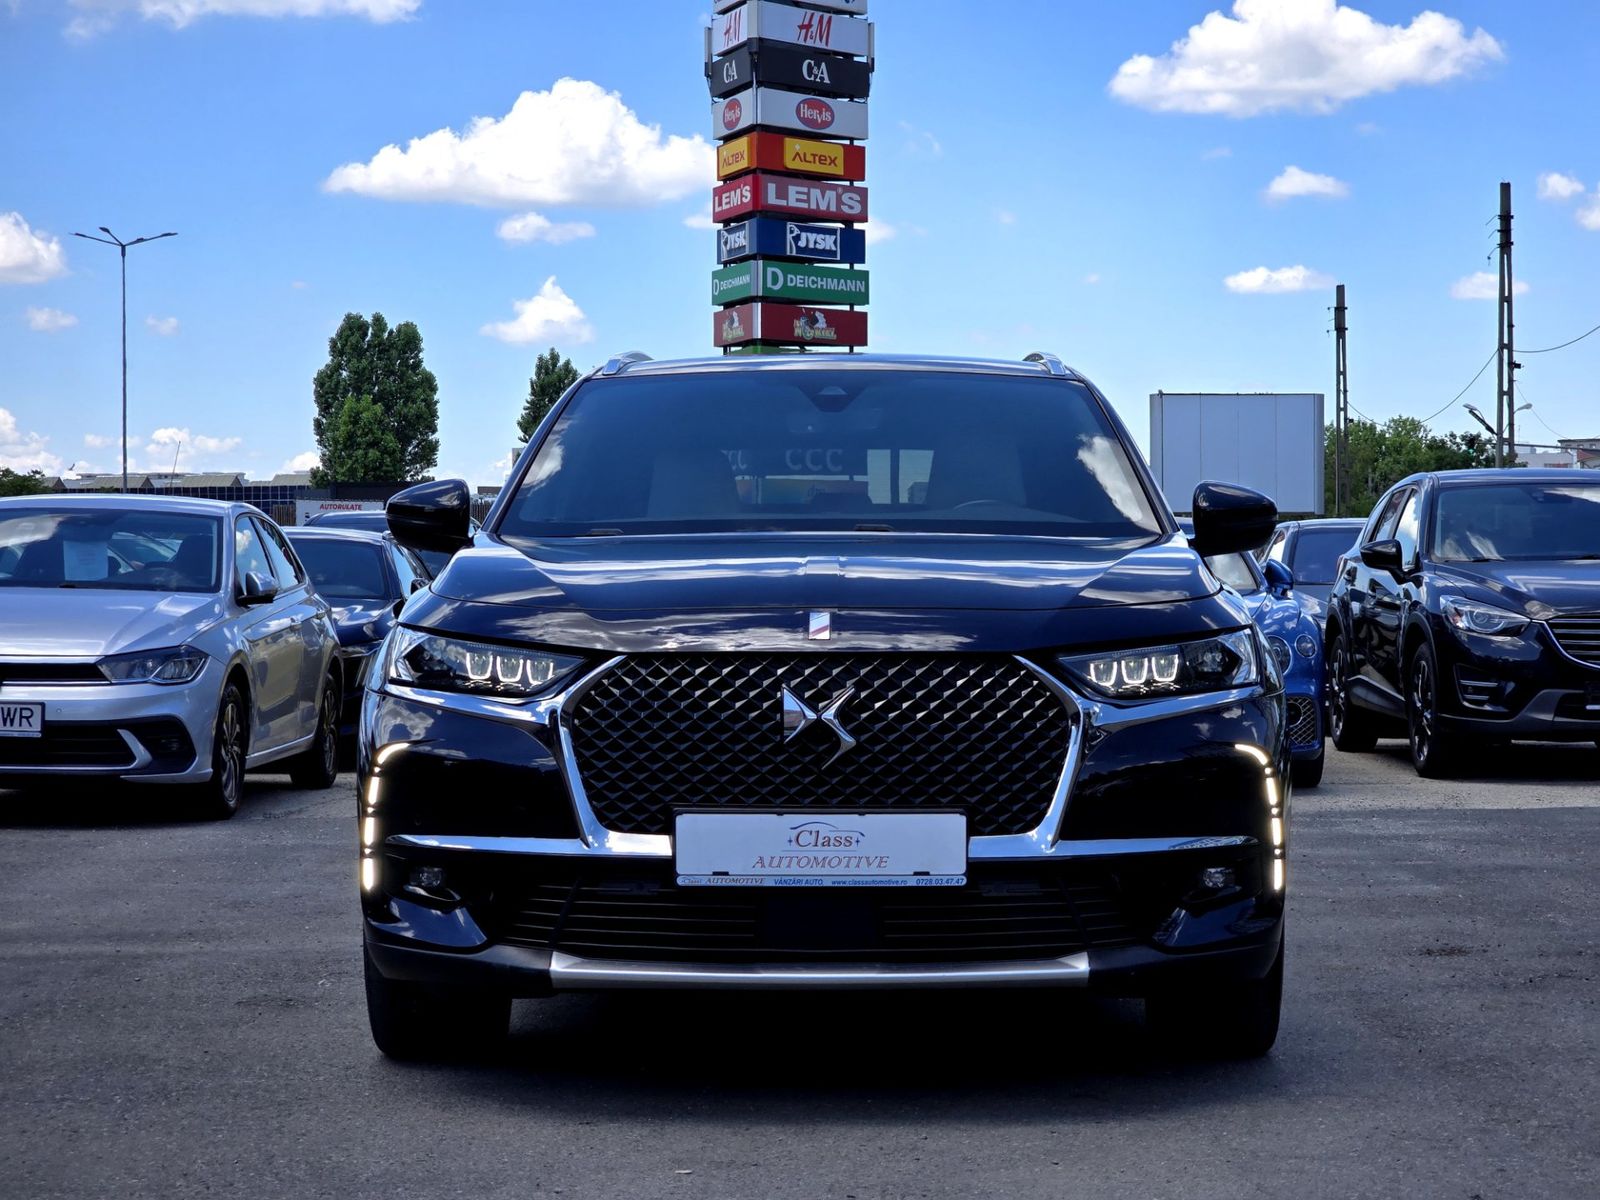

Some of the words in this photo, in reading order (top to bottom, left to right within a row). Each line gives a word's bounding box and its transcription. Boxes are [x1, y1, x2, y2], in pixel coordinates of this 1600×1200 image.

[797, 11, 833, 47] H&M
[723, 59, 738, 84] C&A
[802, 59, 831, 84] C&A
[724, 105, 741, 123] Hervis
[800, 103, 832, 124] Hervis
[714, 184, 751, 213] LEM'S
[726, 230, 747, 251] JYSK
[797, 232, 837, 251] JYSK
[720, 274, 750, 291] DEICHMANN
[766, 266, 784, 290] D
[787, 273, 865, 293] DEICHMANN
[785, 448, 843, 472] CCC
[319, 503, 363, 511] AUTORULATE
[794, 829, 853, 848] Class
[751, 855, 890, 869] AUTOMOTIVE
[704, 877, 765, 885] AUTOMOTIVE
[831, 878, 908, 886] www.classautomotive.ro
